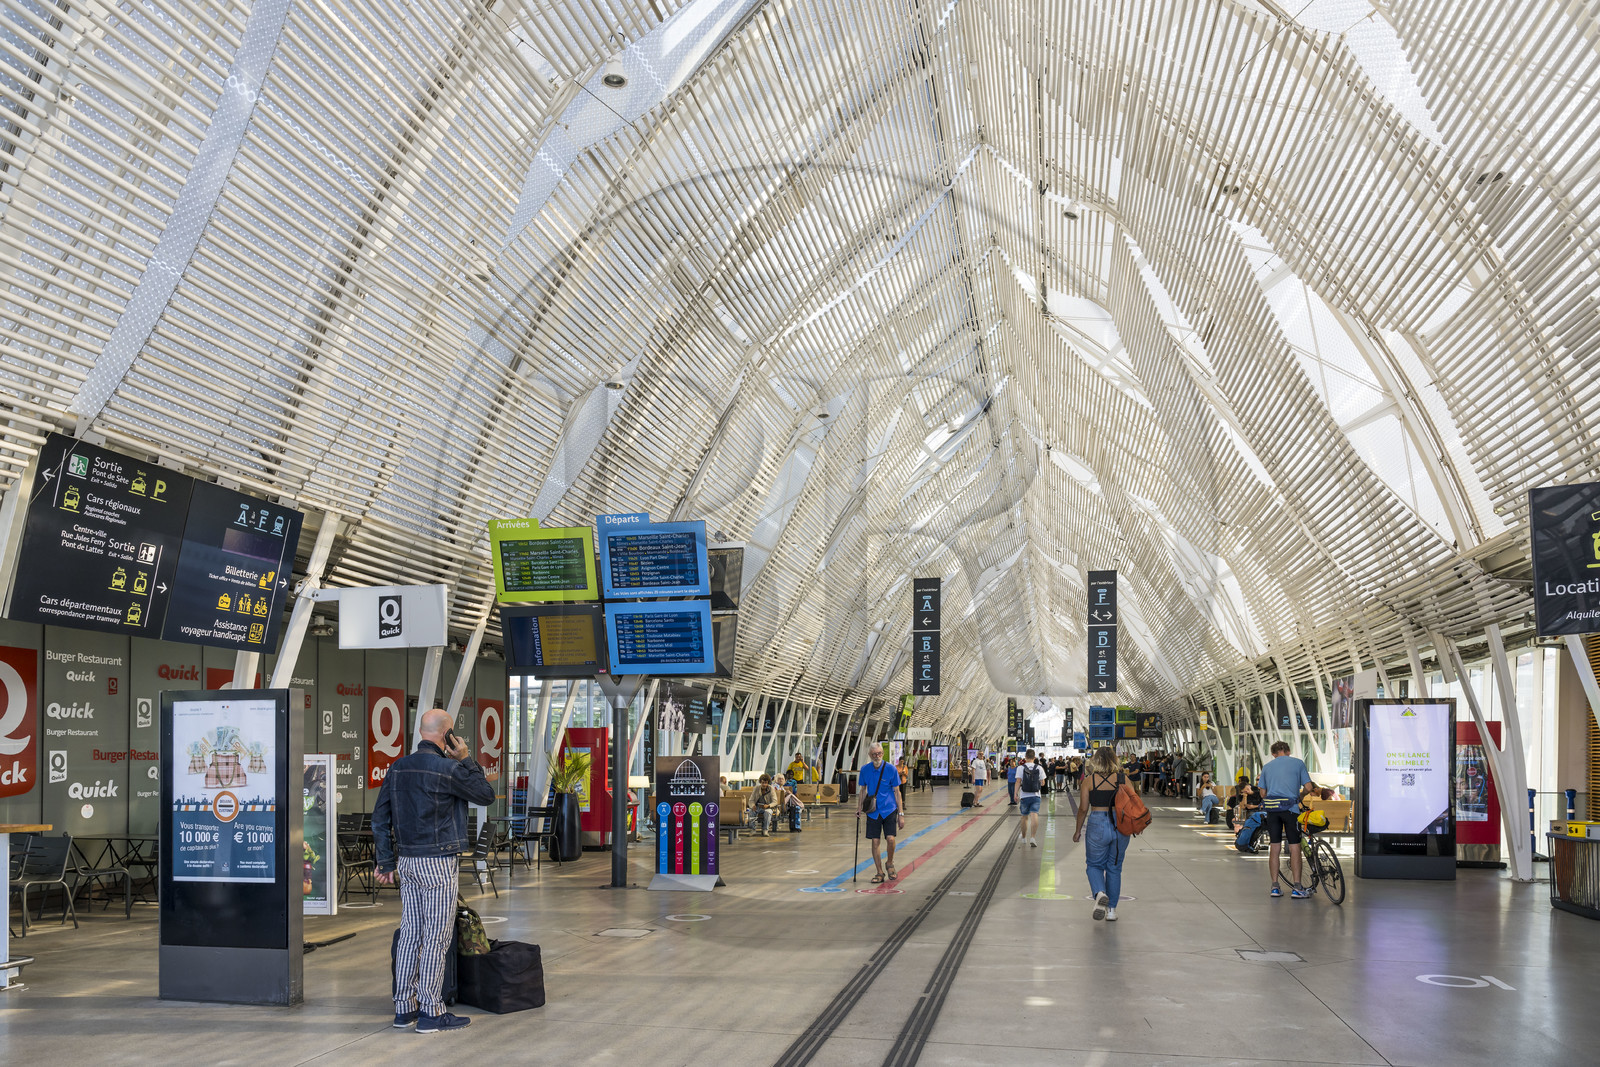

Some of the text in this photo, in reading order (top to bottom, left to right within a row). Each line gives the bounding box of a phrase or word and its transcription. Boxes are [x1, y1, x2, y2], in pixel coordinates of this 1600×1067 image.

[94, 457, 122, 474] Sortie
[92, 468, 106, 478] Pont
[116, 476, 129, 484] Sète
[154, 480, 166, 497] P
[87, 493, 140, 514] Cars régionaux
[238, 510, 246, 523] A
[259, 516, 267, 528] F
[605, 515, 639, 525] Départs
[61, 530, 106, 547] Rue Jules Ferry
[73, 524, 107, 538] Centre-ville
[62, 540, 76, 549] Pont
[86, 545, 104, 555] Lattes
[108, 538, 135, 553] Sortie
[225, 565, 258, 580] Billetterie
[1545, 578, 1600, 596] Locati
[40, 594, 122, 615] Cars départementaux
[923, 600, 931, 609] A
[1099, 594, 1106, 603] F
[39, 607, 85, 618] correspondance
[96, 615, 120, 624] tramway
[381, 599, 400, 625] Q
[214, 619, 248, 632] Assistance
[381, 627, 400, 636] Quick
[181, 626, 246, 643] voyageur handicapé
[532, 618, 542, 666] information
[1099, 636, 1108, 645] D
[924, 641, 930, 650] B
[46, 651, 122, 666] Burger Restaurant
[66, 671, 95, 682] Quick
[158, 664, 199, 681] Quick
[923, 669, 930, 678] C
[1099, 665, 1106, 674] E
[336, 683, 363, 696] Quick
[46, 702, 94, 719] Quick
[138, 701, 151, 719] Q
[324, 713, 331, 727] Q
[372, 696, 402, 757] Q
[342, 731, 357, 739] Quick
[480, 706, 502, 758] Q
[51, 753, 66, 774] Q
[93, 749, 127, 763] Burger
[68, 780, 118, 799] Quick
[195, 823, 219, 831] transportez
[180, 831, 219, 842] 10 000 €
[234, 832, 273, 843] € 10 000
